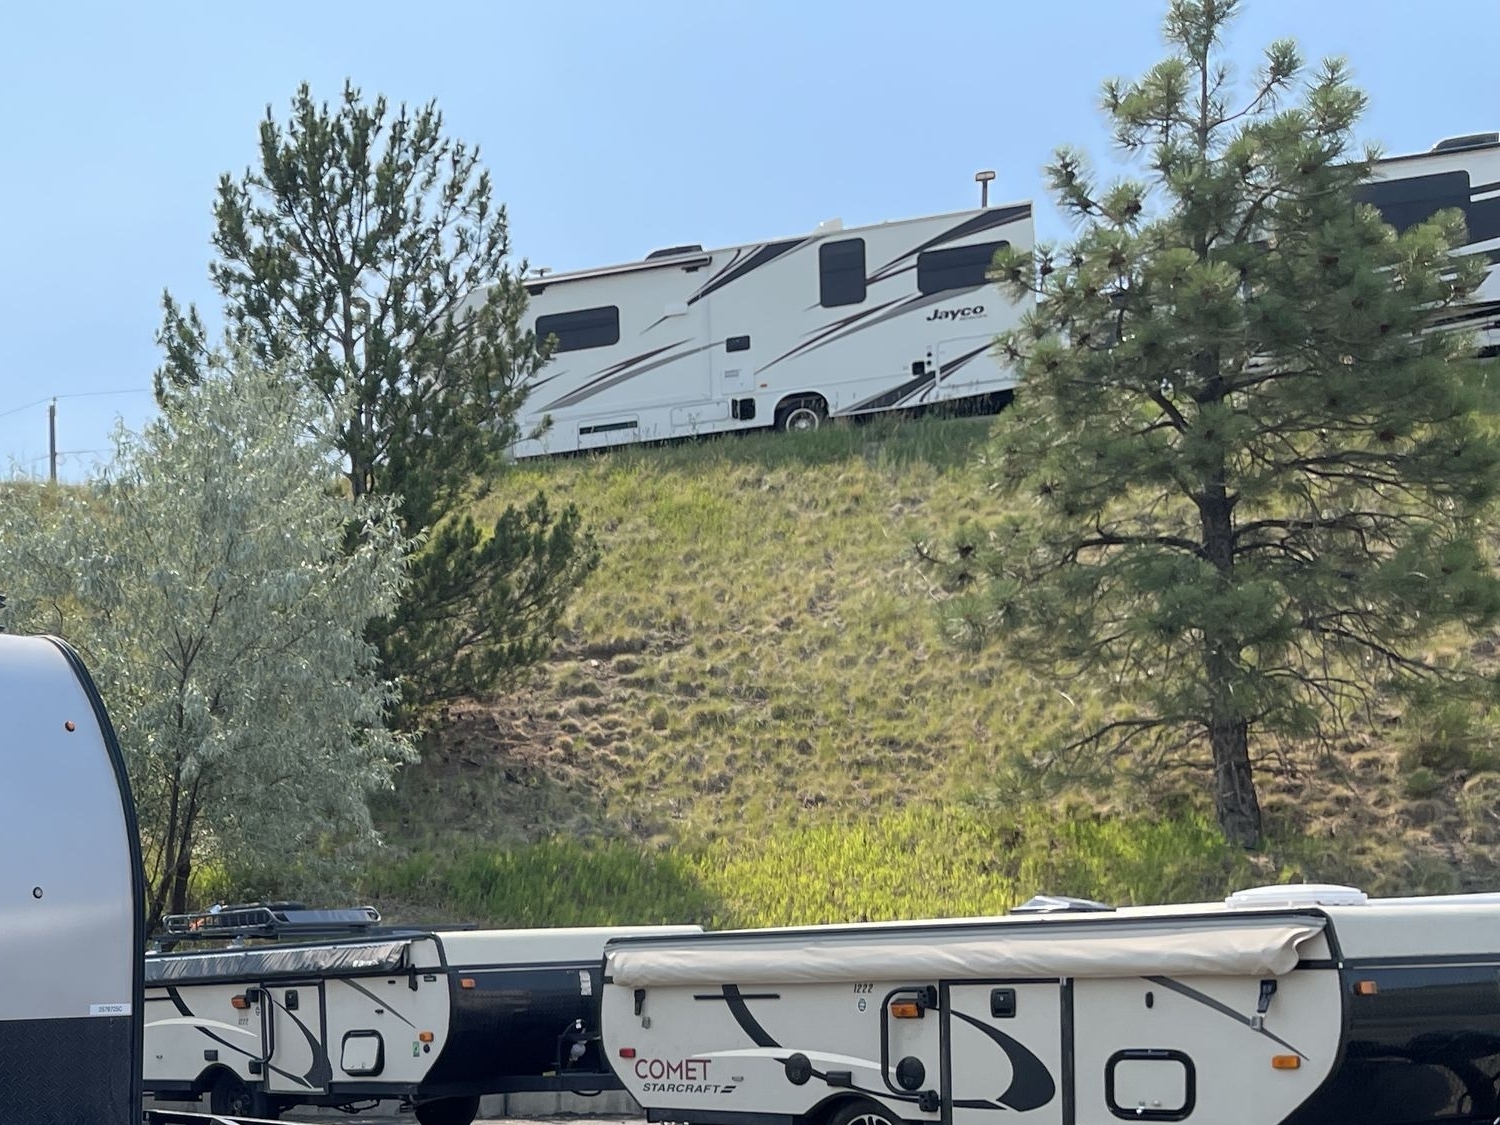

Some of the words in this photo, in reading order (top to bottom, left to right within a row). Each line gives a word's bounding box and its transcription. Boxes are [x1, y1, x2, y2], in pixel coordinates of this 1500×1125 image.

[926, 305, 985, 321] Jayco
[853, 983, 874, 994] 1222
[635, 1059, 711, 1080] COMET
[643, 1082, 721, 1094] STARCRAFT
